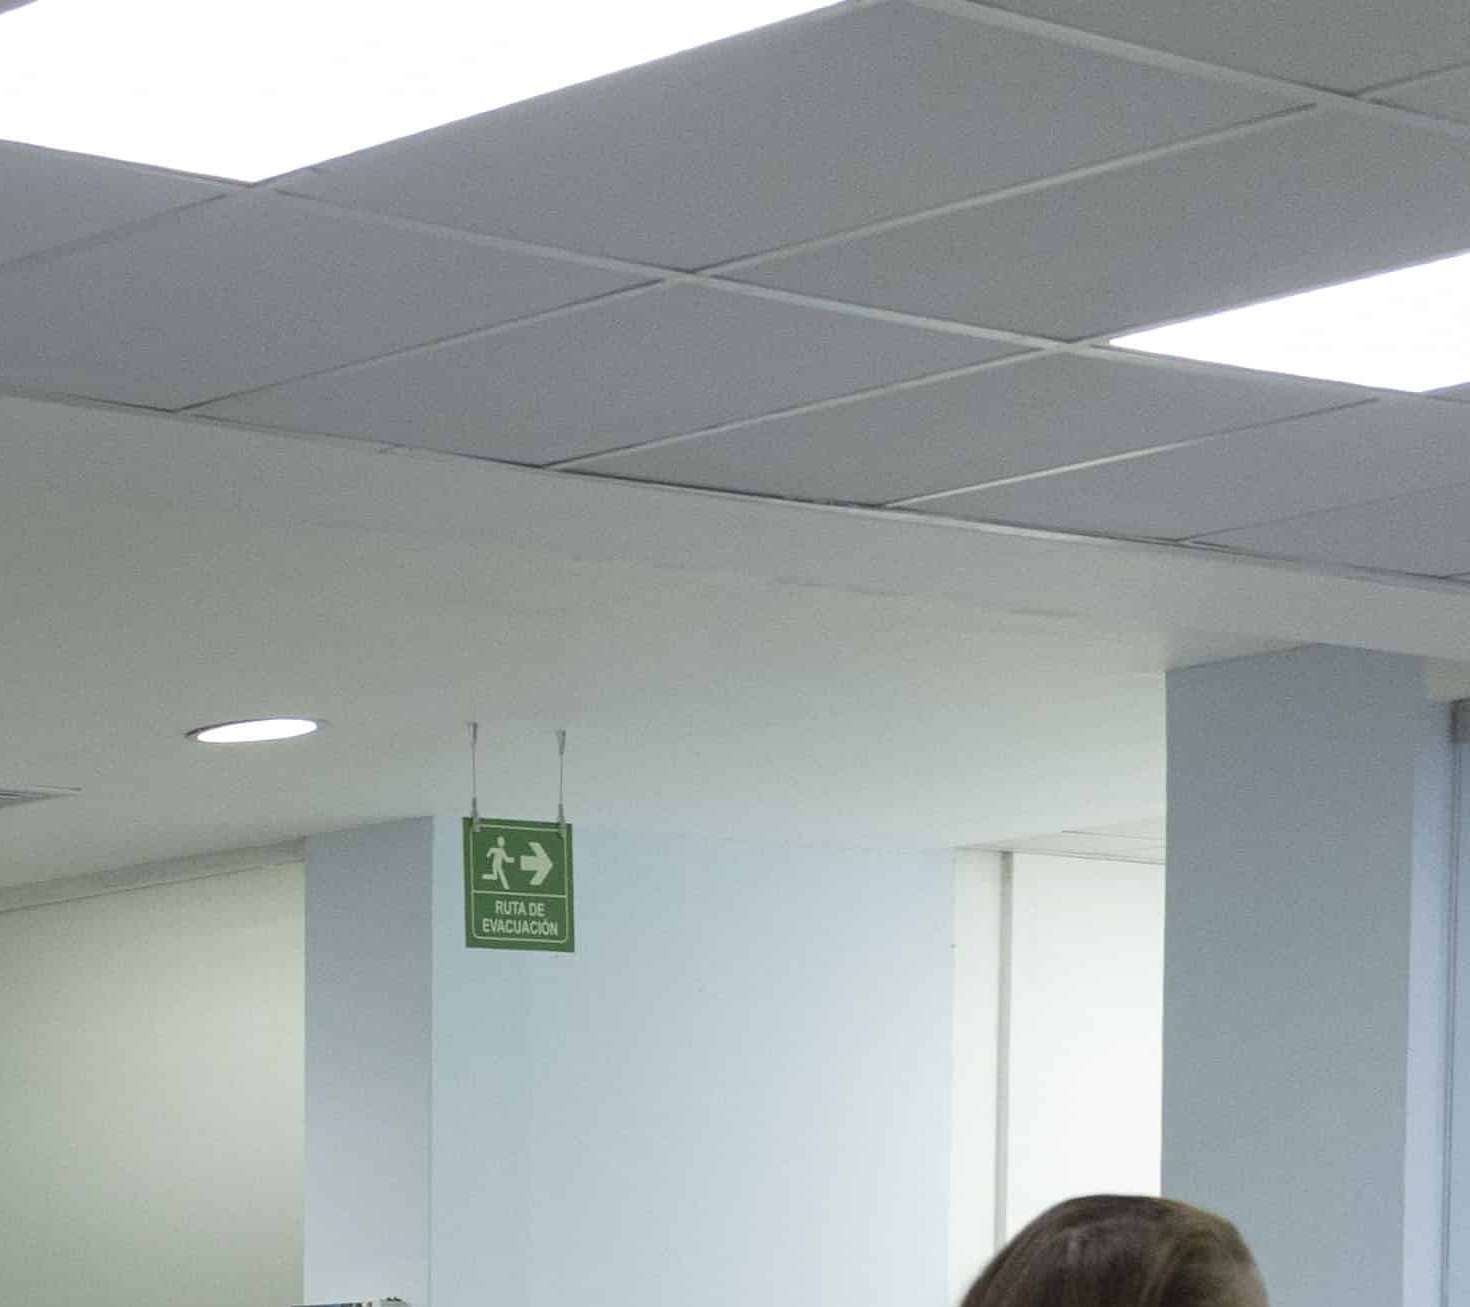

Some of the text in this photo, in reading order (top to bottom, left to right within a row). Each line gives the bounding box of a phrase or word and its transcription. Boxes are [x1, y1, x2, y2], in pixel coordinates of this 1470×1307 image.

[495, 900, 546, 918] RUTA DE
[482, 917, 559, 936] EVACUACIÓN
